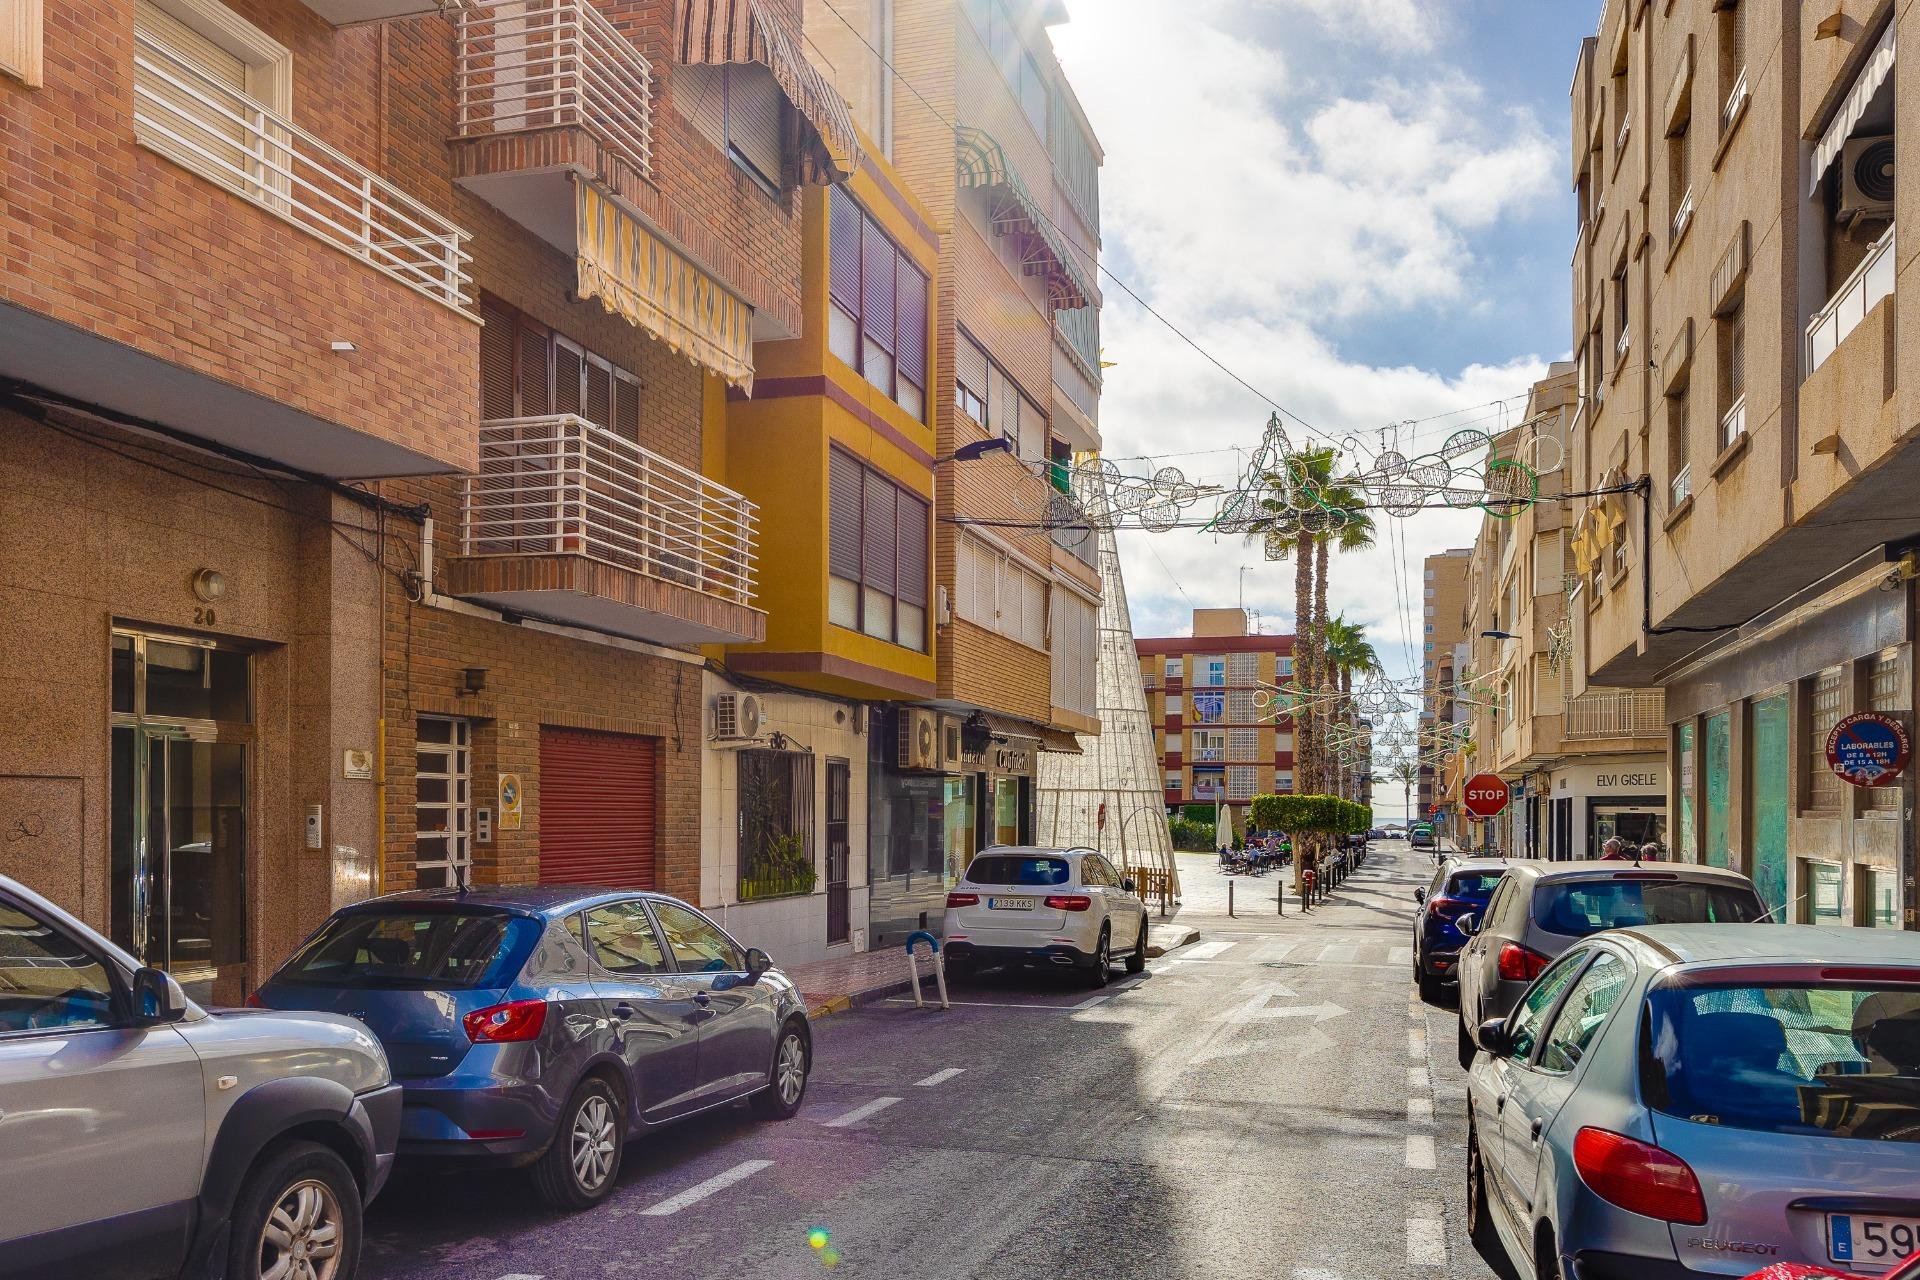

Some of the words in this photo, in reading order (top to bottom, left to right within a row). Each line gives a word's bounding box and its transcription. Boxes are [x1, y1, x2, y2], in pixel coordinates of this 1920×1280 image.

[194, 606, 216, 626] 20
[1828, 722, 1847, 754] EXCEPTO
[1846, 713, 1876, 725] CARGA
[1884, 717, 1909, 754] DESCARGA
[1841, 741, 1895, 750] LABORABLES
[1597, 774, 1617, 787] ELVI
[1620, 773, 1657, 786] GISELE
[1468, 790, 1505, 800] STOP
[993, 899, 1014, 908] 2139
[1016, 899, 1032, 908] KKS
[1687, 1237, 1780, 1256] PEUGEOT
[1838, 1242, 1847, 1252] E
[1863, 1221, 1920, 1258] 59
